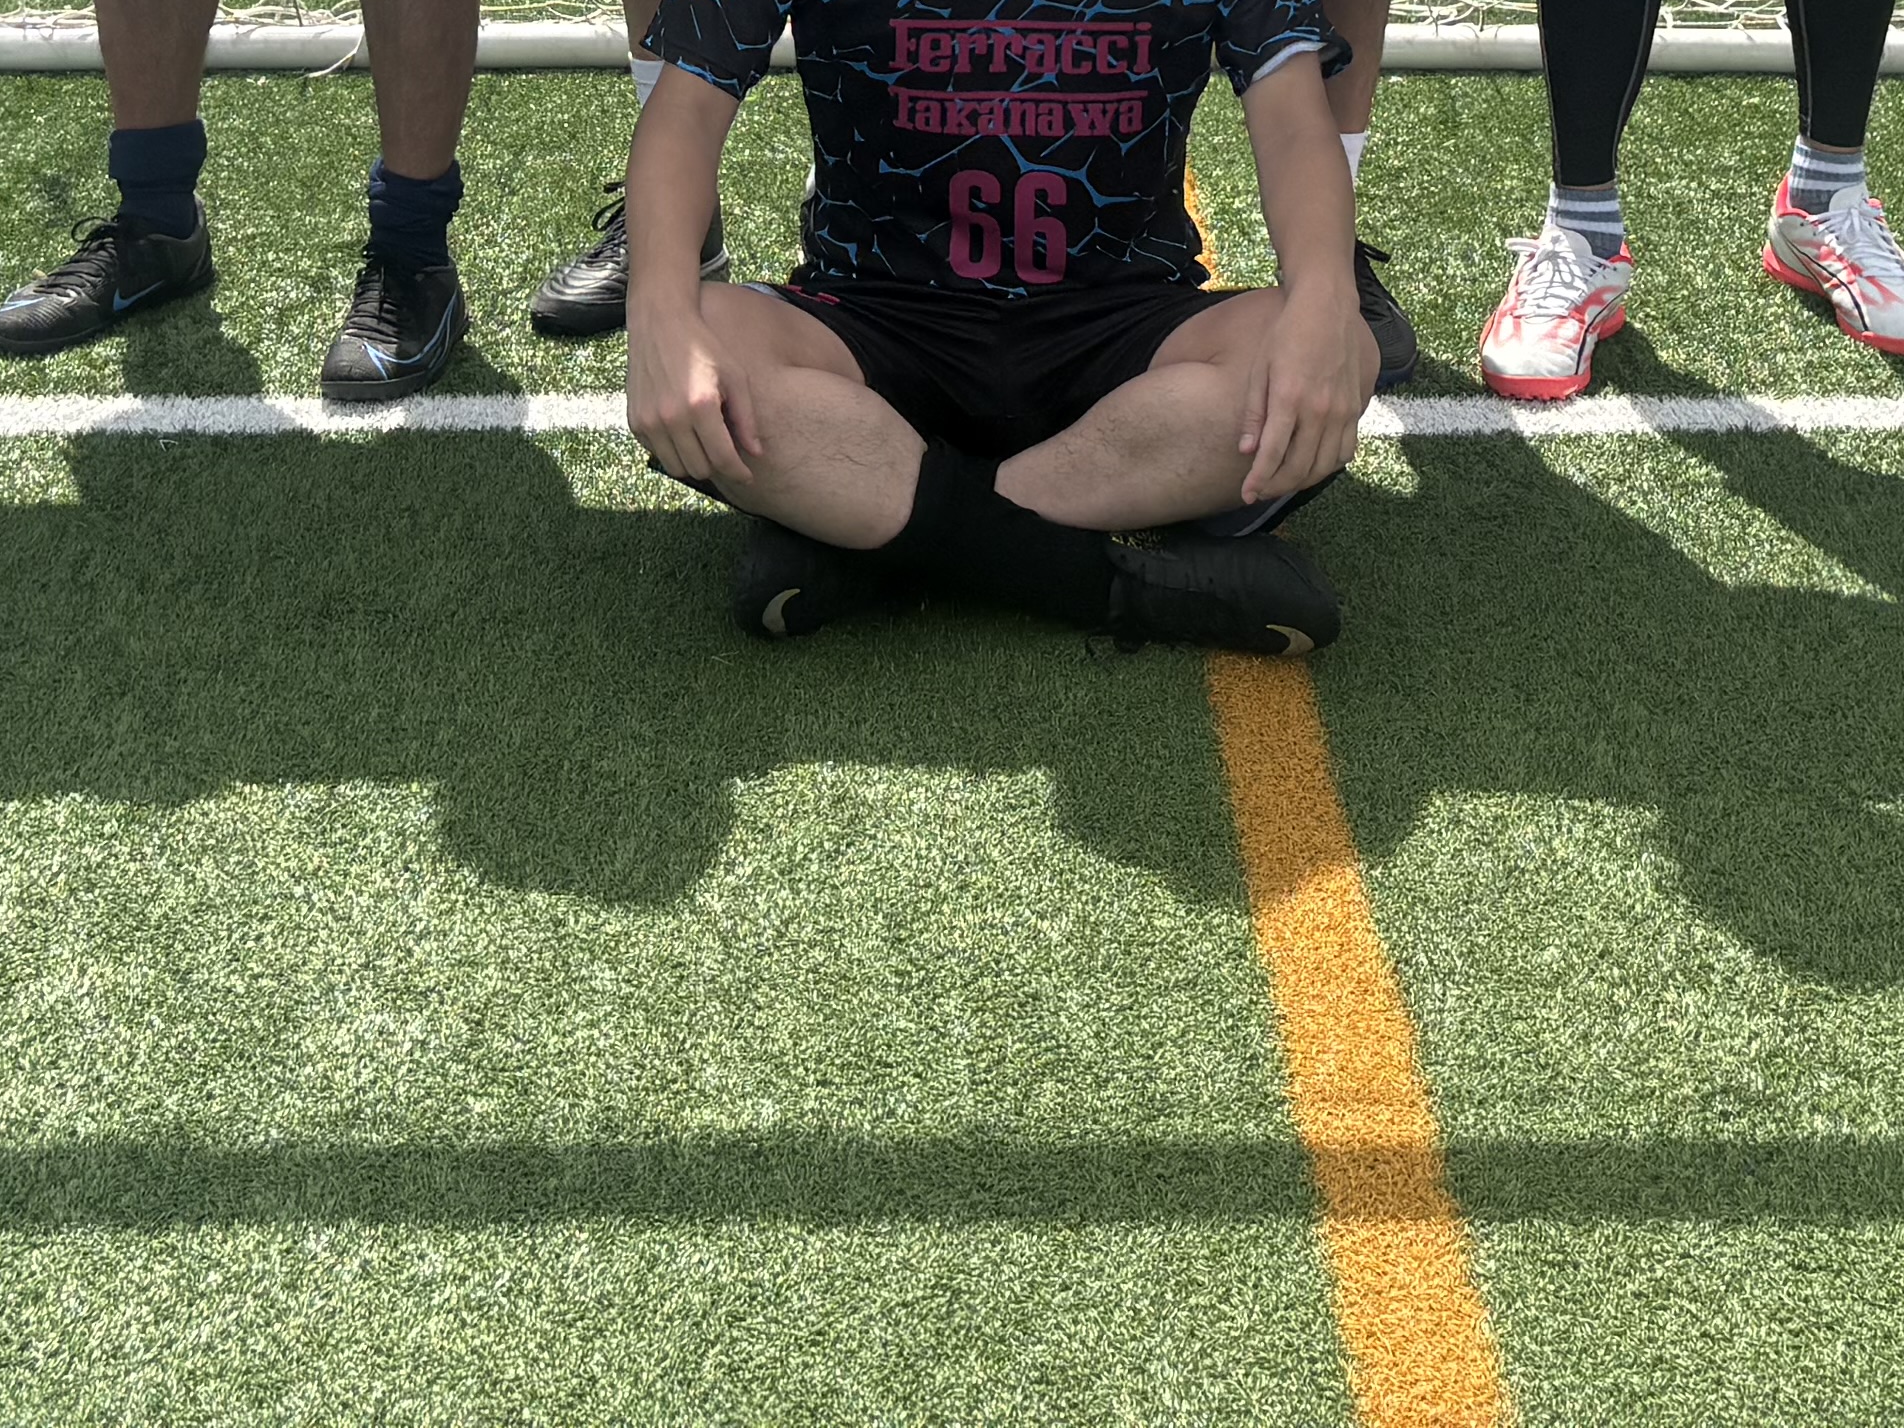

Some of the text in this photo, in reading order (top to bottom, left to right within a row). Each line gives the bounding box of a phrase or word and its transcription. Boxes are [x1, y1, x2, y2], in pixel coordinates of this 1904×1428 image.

[889, 18, 1153, 75] Ferracci
[888, 85, 1149, 138] Takanawa
[948, 169, 1068, 285] 66
